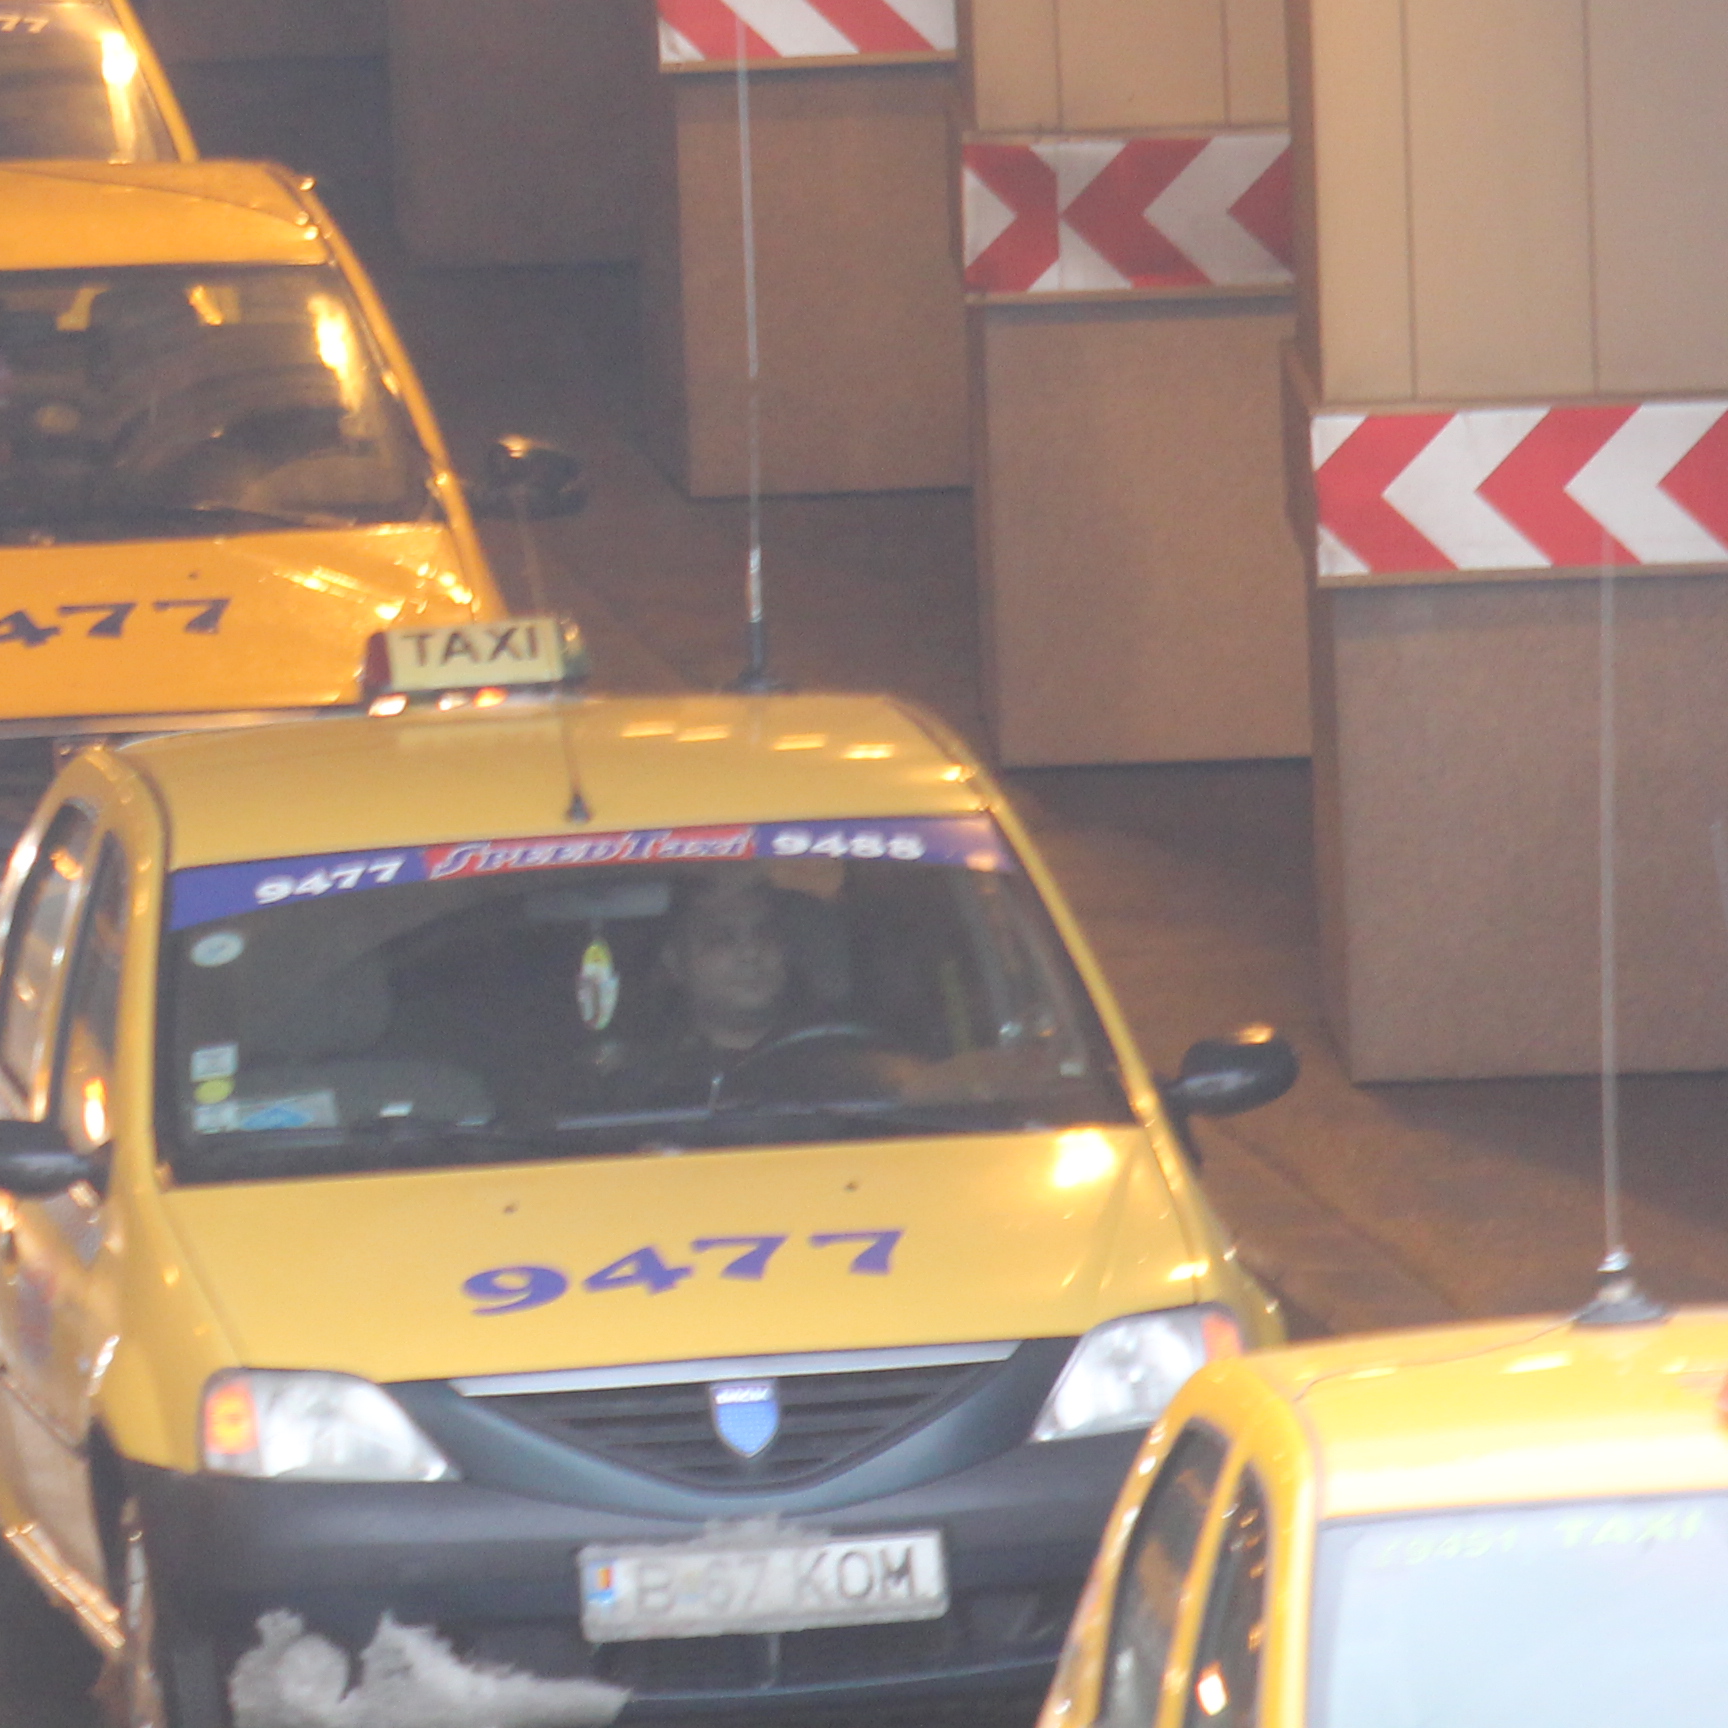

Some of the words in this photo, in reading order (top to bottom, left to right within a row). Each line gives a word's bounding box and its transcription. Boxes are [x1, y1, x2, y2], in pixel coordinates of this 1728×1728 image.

[405, 623, 538, 669] TAXI
[254, 857, 405, 904] 9477
[773, 832, 924, 859] 9488
[461, 1230, 904, 1315] 9477
[1554, 1508, 1704, 1548] TAXI
[636, 1564, 674, 1614] B
[794, 1545, 915, 1603] KOM
